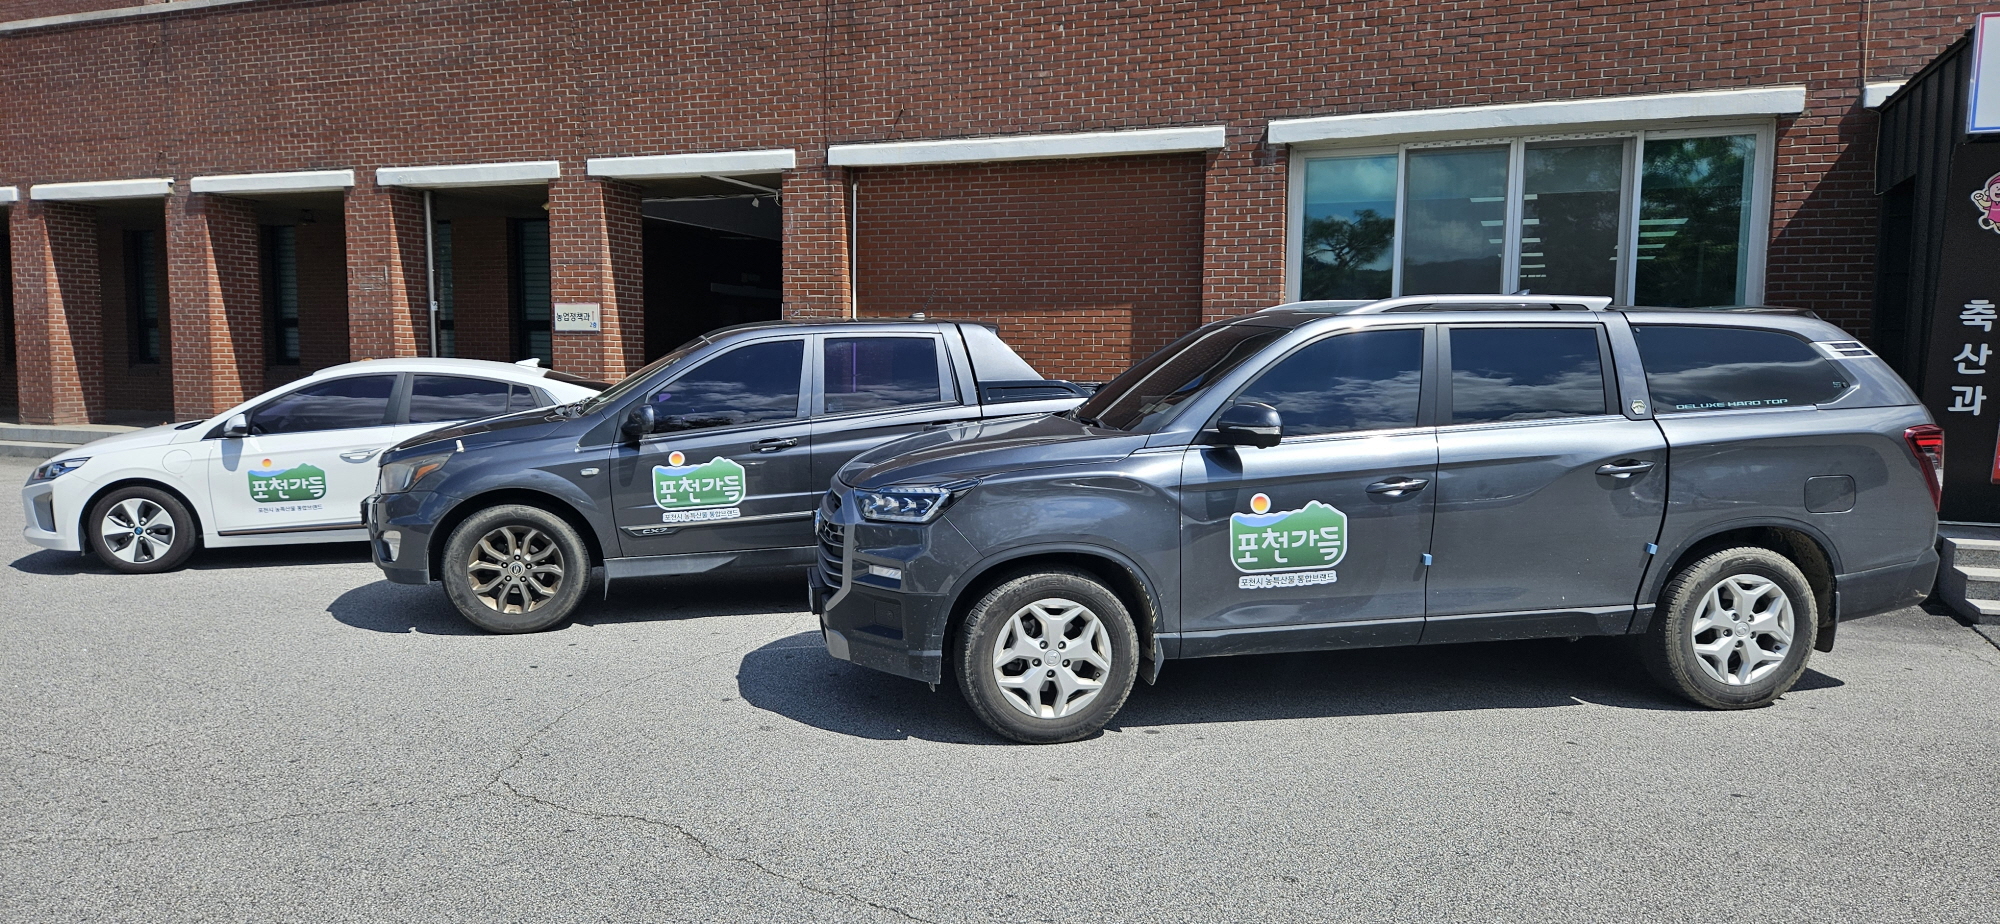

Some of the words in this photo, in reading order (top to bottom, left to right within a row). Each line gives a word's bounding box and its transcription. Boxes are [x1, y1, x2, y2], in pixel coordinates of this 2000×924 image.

[556, 312, 590, 322] 농업정책과
[1947, 299, 1998, 416] 축산과
[1675, 401, 1725, 410] DELUXE
[252, 476, 325, 499] 포천가득
[659, 475, 742, 504] 포천가득
[1237, 526, 1341, 563] 포천가득
[1240, 577, 1263, 587] 포천시
[1265, 575, 1295, 586] 농특산물
[1296, 572, 1335, 584] 통합브랜드
